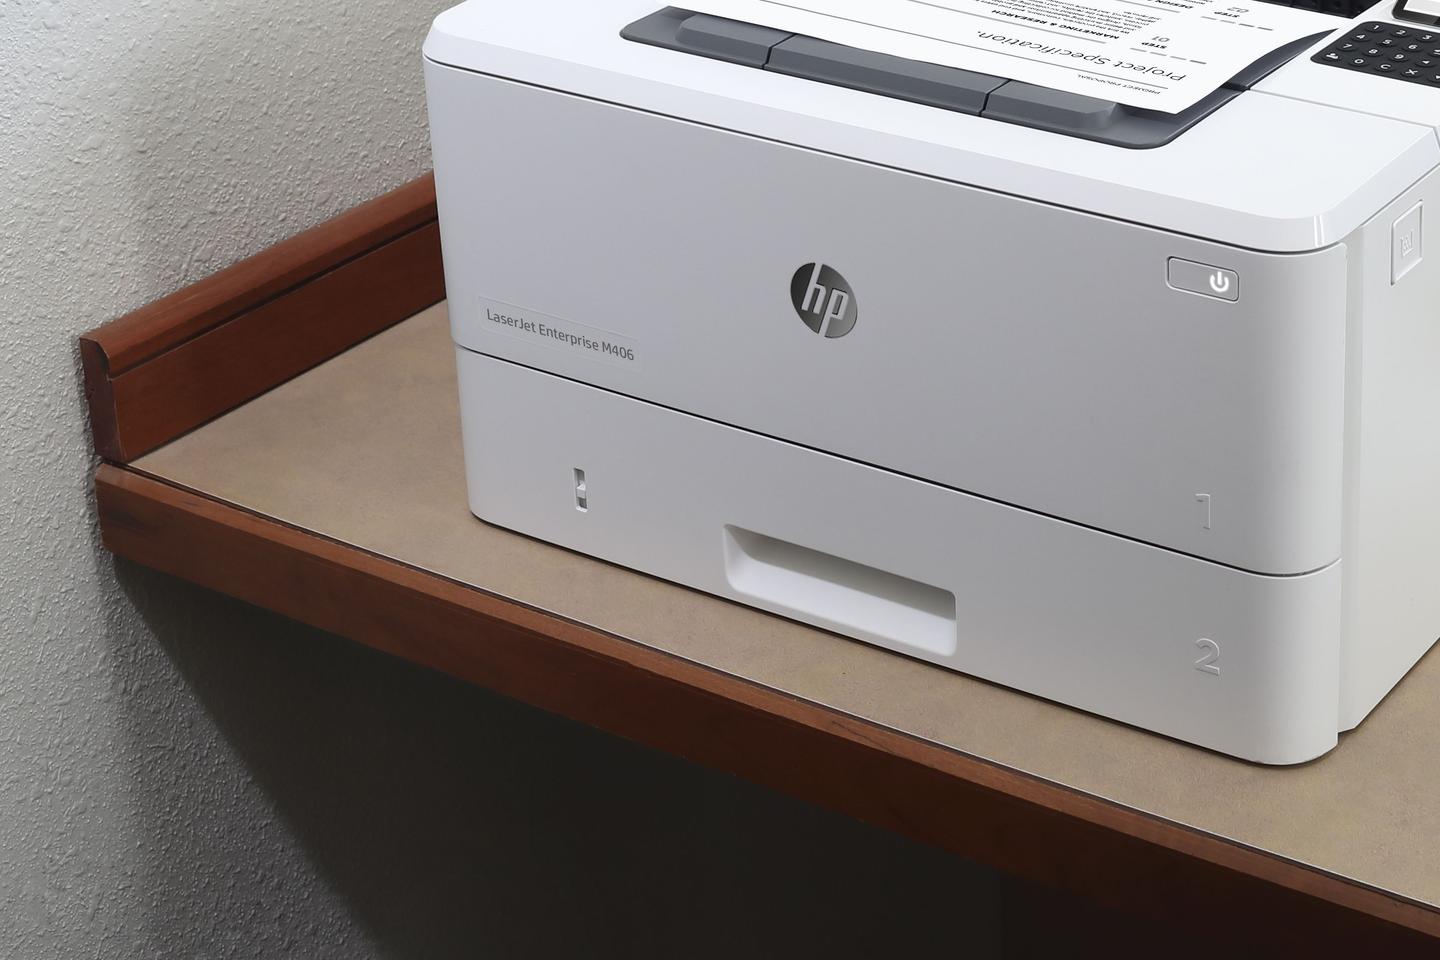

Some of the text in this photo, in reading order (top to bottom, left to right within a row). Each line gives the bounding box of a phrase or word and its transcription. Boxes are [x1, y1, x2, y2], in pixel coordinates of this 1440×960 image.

[1154, 0, 1194, 10] DESIGN
[1220, 6, 1250, 15] 02
[991, 9, 1048, 25] RESEARCH
[1058, 24, 1120, 40] MARKETING
[1148, 35, 1171, 45] 01
[1141, 42, 1168, 50] STEP
[977, 30, 1187, 81] Project Specification.
[486, 308, 635, 361] LaserJet Enterprise M406
[1195, 494, 1211, 530] 1
[1194, 638, 1220, 676] 2
